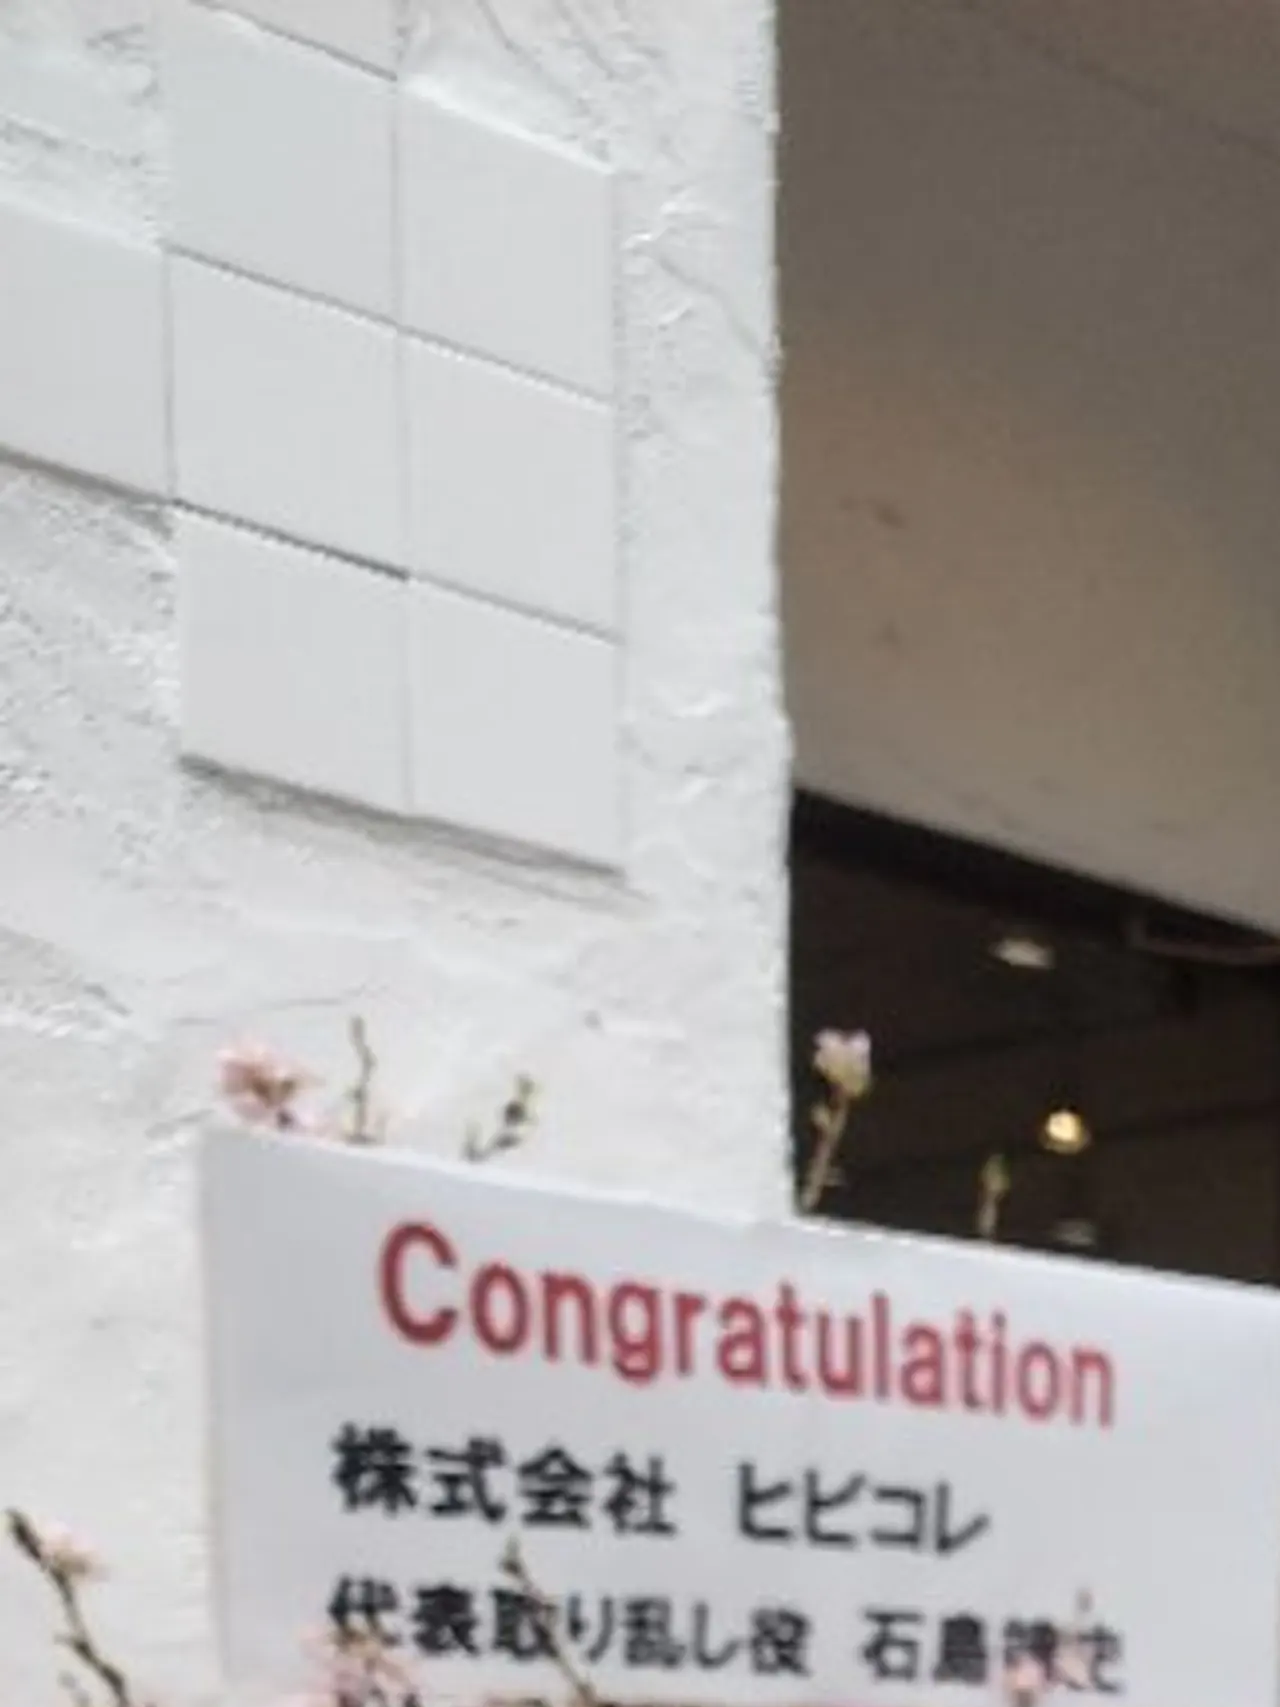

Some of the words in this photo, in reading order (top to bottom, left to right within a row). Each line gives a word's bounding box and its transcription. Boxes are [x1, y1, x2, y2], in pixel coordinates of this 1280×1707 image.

[377, 1221, 1115, 1428] Congratulation
[331, 1422, 677, 1536] 株式会社
